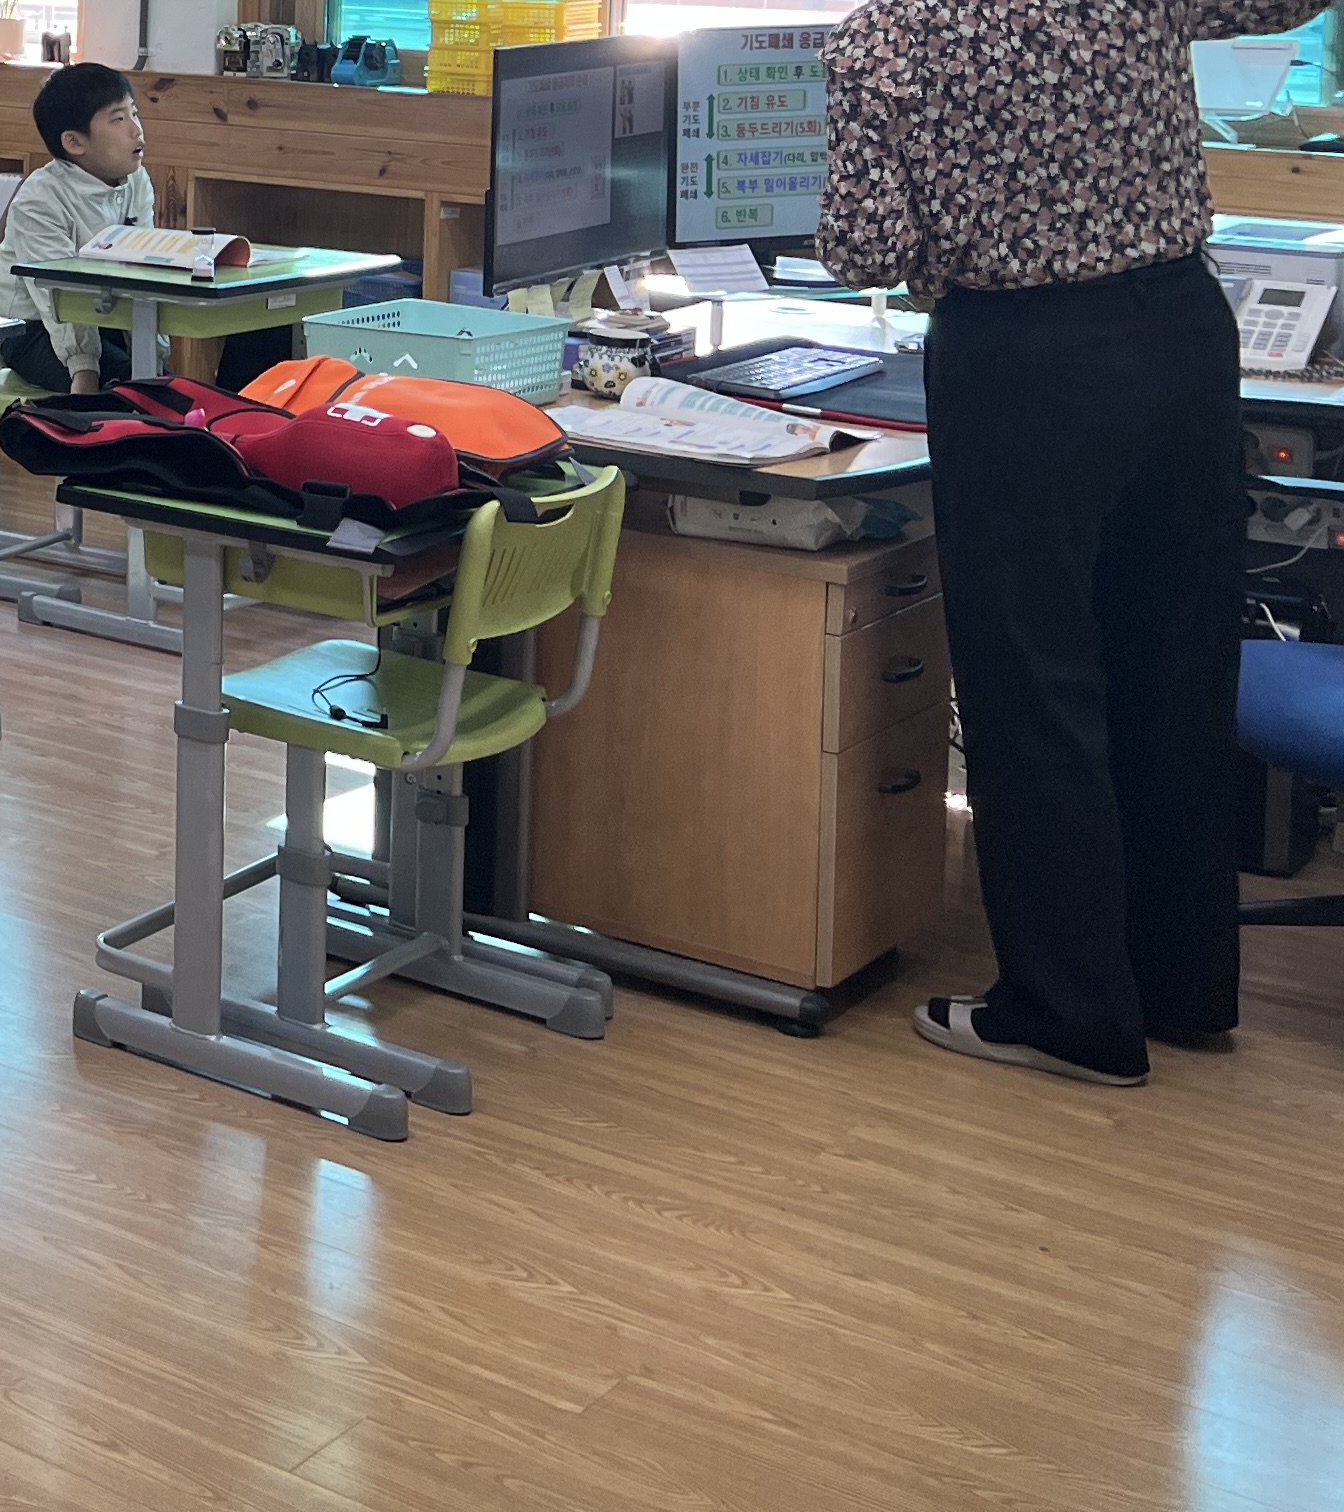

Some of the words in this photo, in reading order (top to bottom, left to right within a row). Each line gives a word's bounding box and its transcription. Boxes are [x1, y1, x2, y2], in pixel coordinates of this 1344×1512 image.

[740, 31, 794, 51] 기도폐쇄
[799, 31, 827, 50] 응급
[723, 69, 733, 82] 1.
[737, 66, 760, 82] 상태
[765, 65, 788, 80] 확인
[793, 65, 804, 78] 후
[722, 97, 733, 111] 2.
[736, 95, 760, 111] 기침
[765, 95, 788, 109] 유도
[682, 114, 700, 125] 기도
[721, 125, 731, 138] 3.
[721, 154, 731, 166] 4.
[680, 175, 699, 187] 기도
[721, 181, 732, 194] 5.
[736, 178, 758, 193] 복부
[721, 210, 731, 223] 6.
[735, 207, 759, 223] 반복
